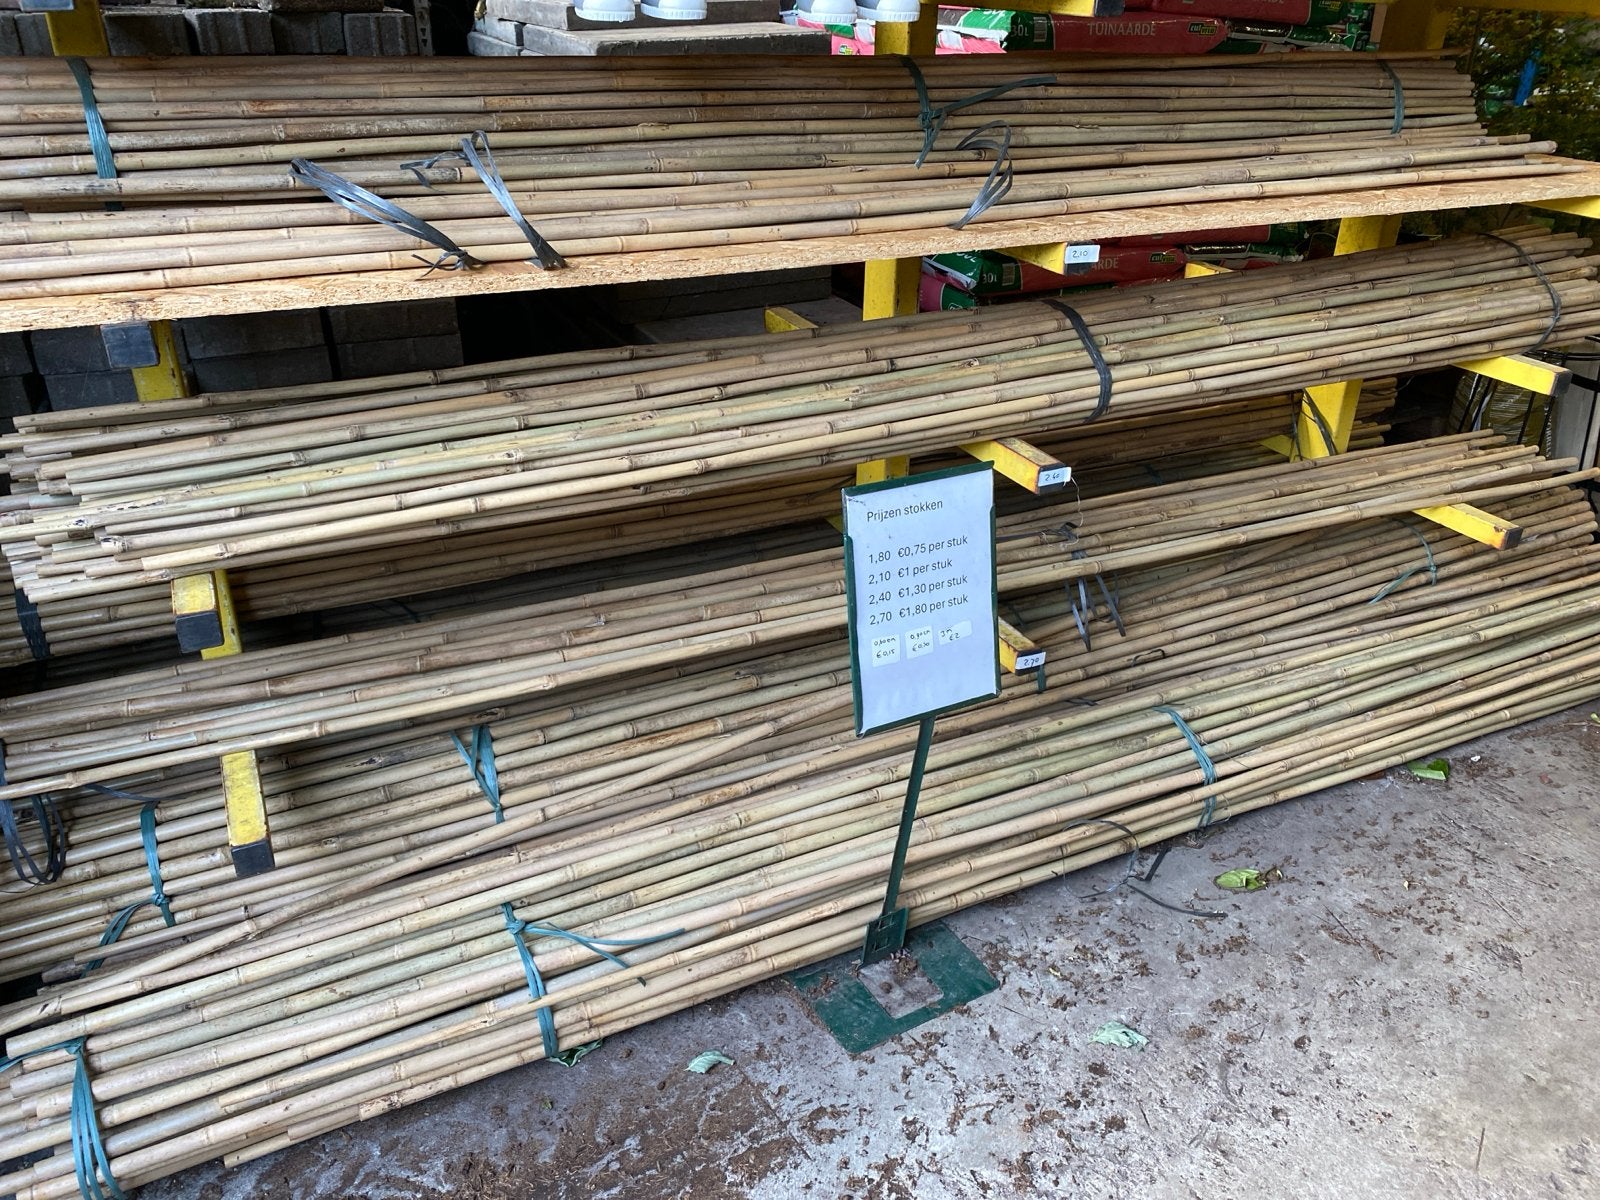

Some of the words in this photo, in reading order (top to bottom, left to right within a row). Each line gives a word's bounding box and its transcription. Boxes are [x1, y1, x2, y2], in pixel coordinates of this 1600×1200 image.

[1087, 21, 1156, 36] TUINAARDE
[867, 508, 902, 522] Prijzen
[904, 500, 943, 515] stokken
[869, 550, 891, 564] 1,80
[898, 543, 926, 558] €0,75
[929, 541, 945, 554] per
[947, 535, 968, 548] stuk
[868, 571, 891, 584] 2,10
[898, 566, 909, 578] €1
[913, 564, 929, 577] per
[932, 558, 953, 571] stuk
[869, 591, 891, 605] 2,40
[898, 583, 926, 597] €1,30
[929, 581, 945, 594] per
[947, 575, 968, 587] stuk
[870, 611, 892, 625] 2,70
[899, 603, 927, 618] €1,80
[930, 600, 946, 613] per
[948, 594, 968, 607] stuk
